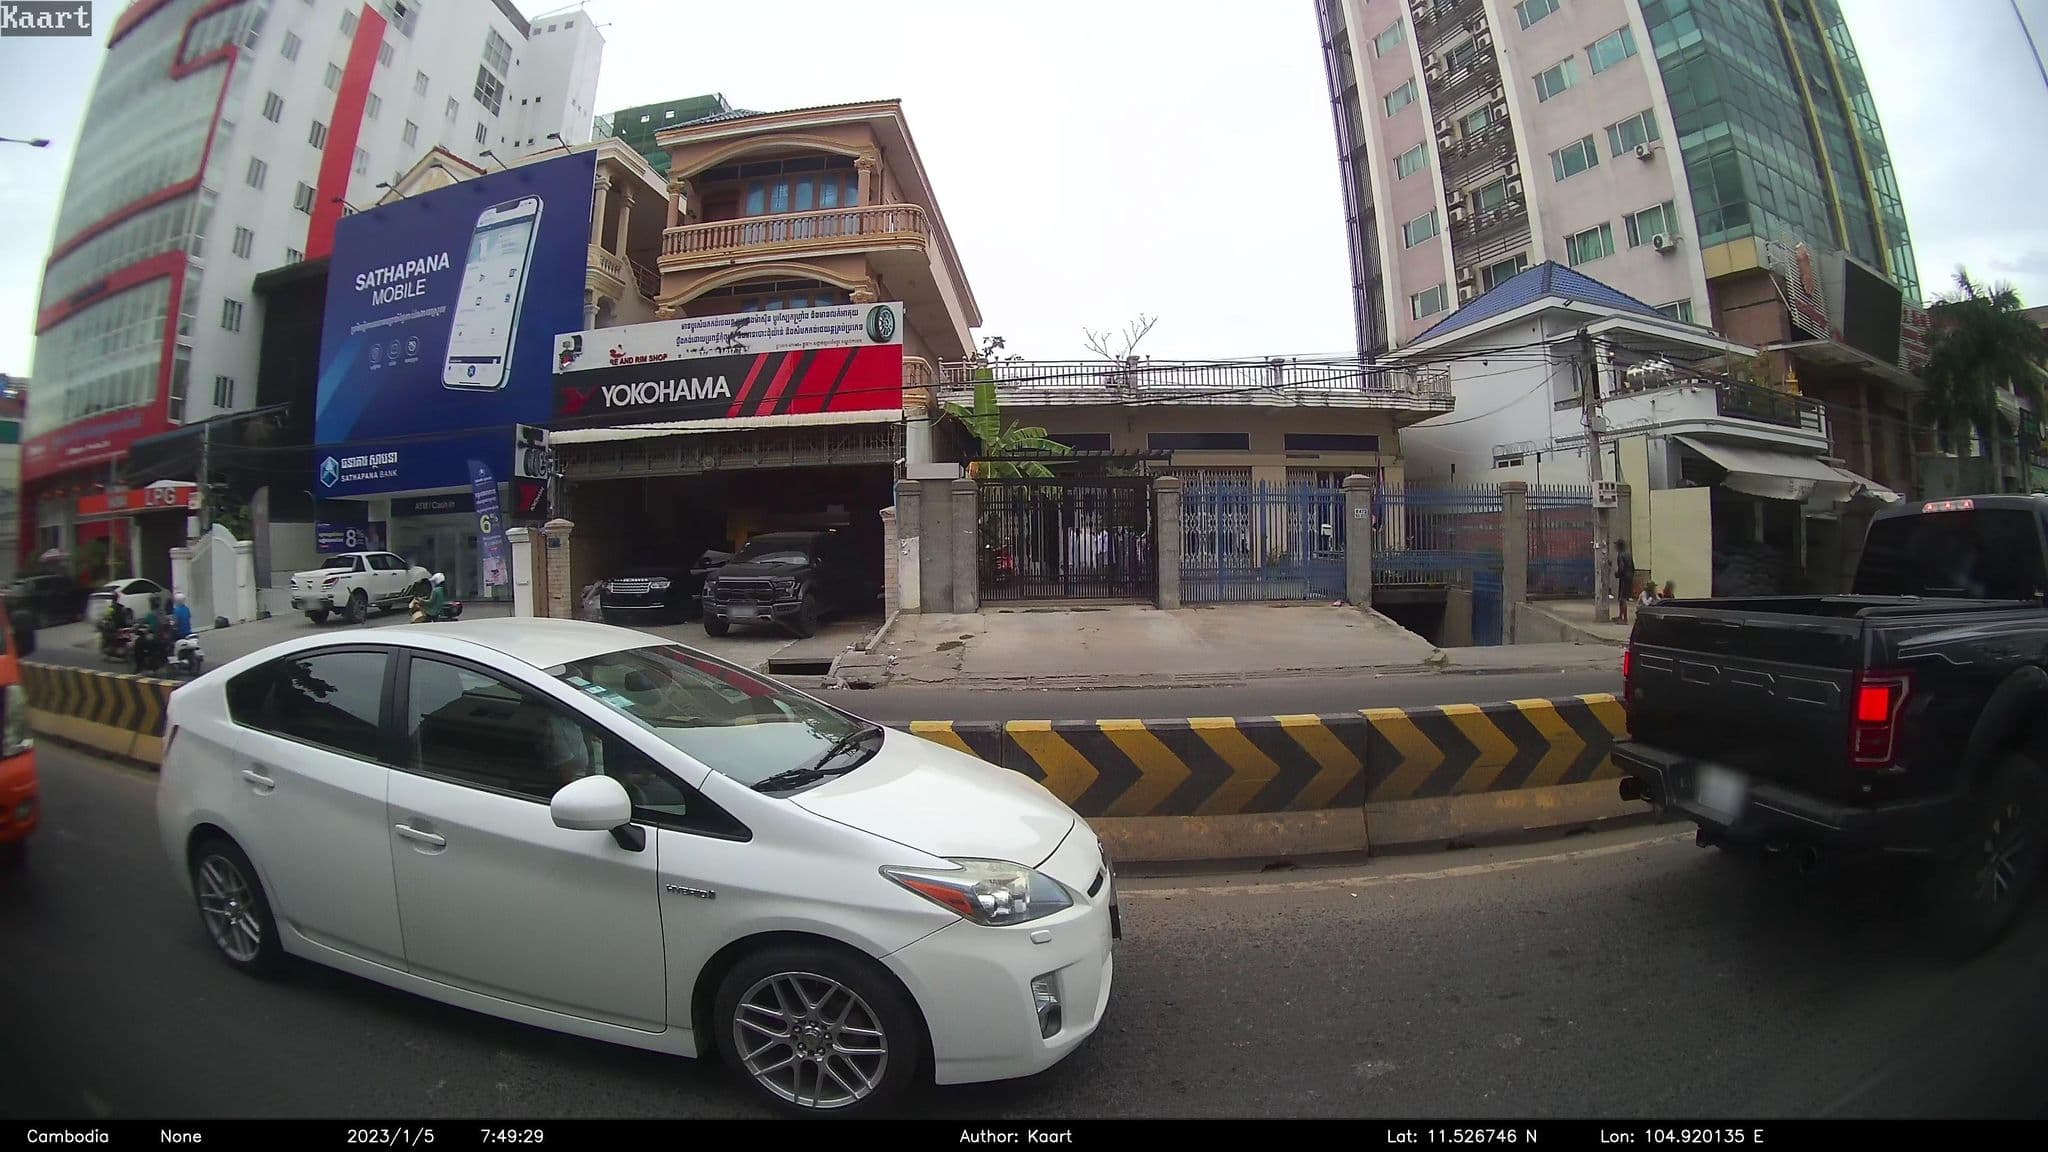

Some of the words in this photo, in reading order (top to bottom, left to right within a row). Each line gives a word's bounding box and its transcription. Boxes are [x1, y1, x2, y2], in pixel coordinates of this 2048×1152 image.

[355, 252, 450, 291] SATHAPANA
[371, 278, 426, 306] MOBILE
[620, 355, 634, 365] AND
[635, 354, 648, 363] RIM
[648, 353, 668, 362] SHOP
[601, 375, 731, 408] YOKOHAMA
[341, 471, 378, 482] SATHAPANA
[379, 469, 399, 478] BANK
